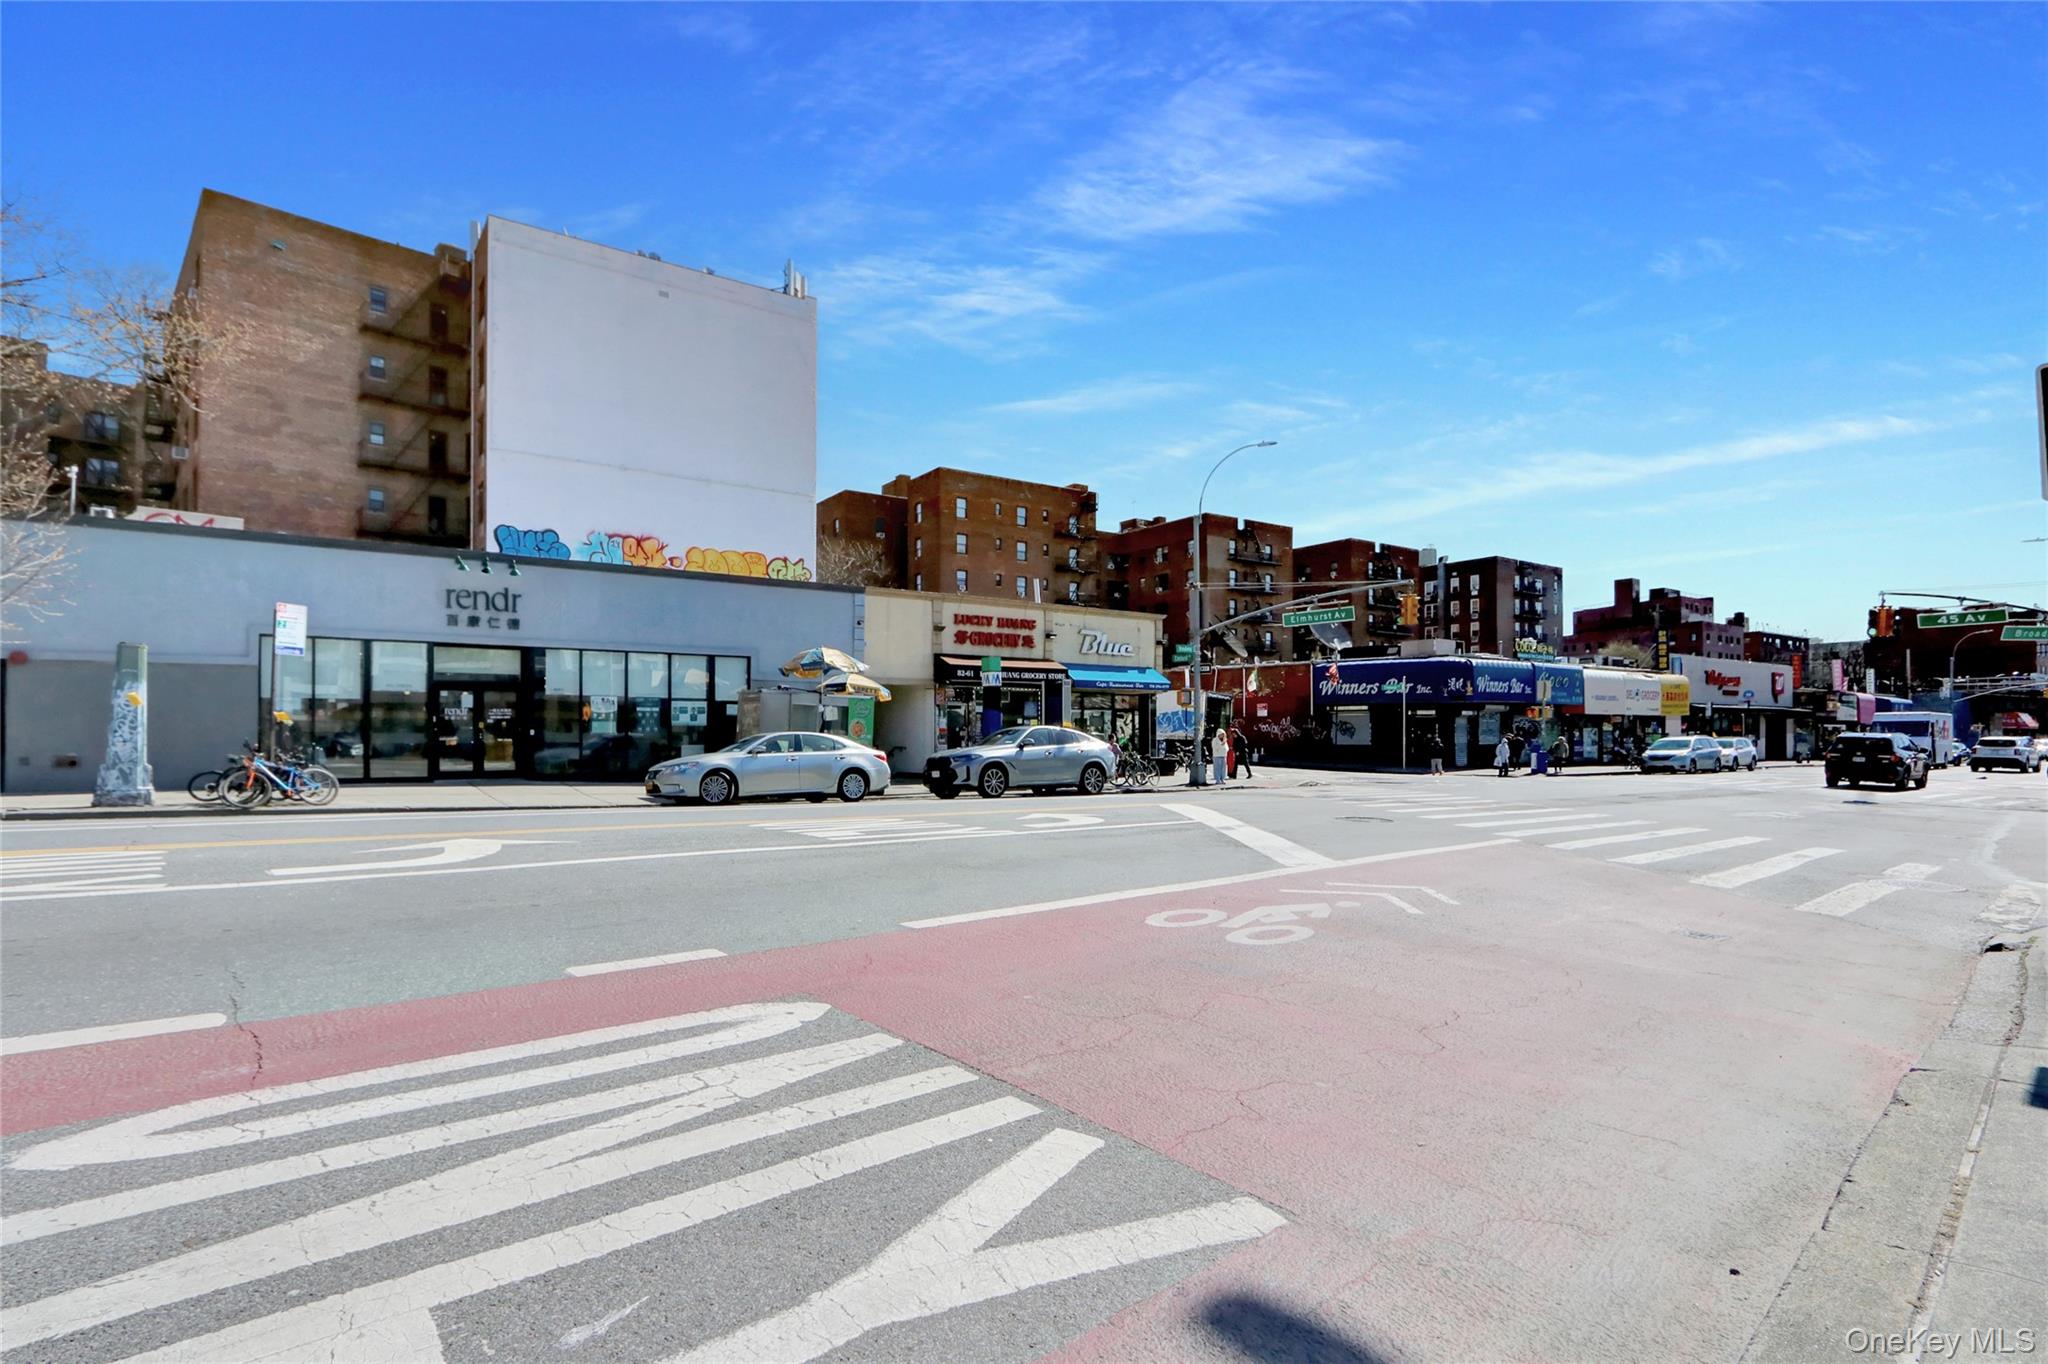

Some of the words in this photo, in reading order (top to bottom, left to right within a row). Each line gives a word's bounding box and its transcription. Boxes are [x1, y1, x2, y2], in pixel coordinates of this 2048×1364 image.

[445, 587, 522, 613] rendr
[1290, 612, 1332, 624] Elmhurst
[1334, 611, 1346, 619] Av
[1937, 615, 1959, 624] 45
[1965, 614, 1986, 623] Av
[1079, 628, 1135, 657] Blue
[957, 669, 974, 678] 82-61
[1319, 679, 1380, 696] Winners
[1477, 674, 1509, 694] Winners
[1510, 678, 1524, 694] Bar
